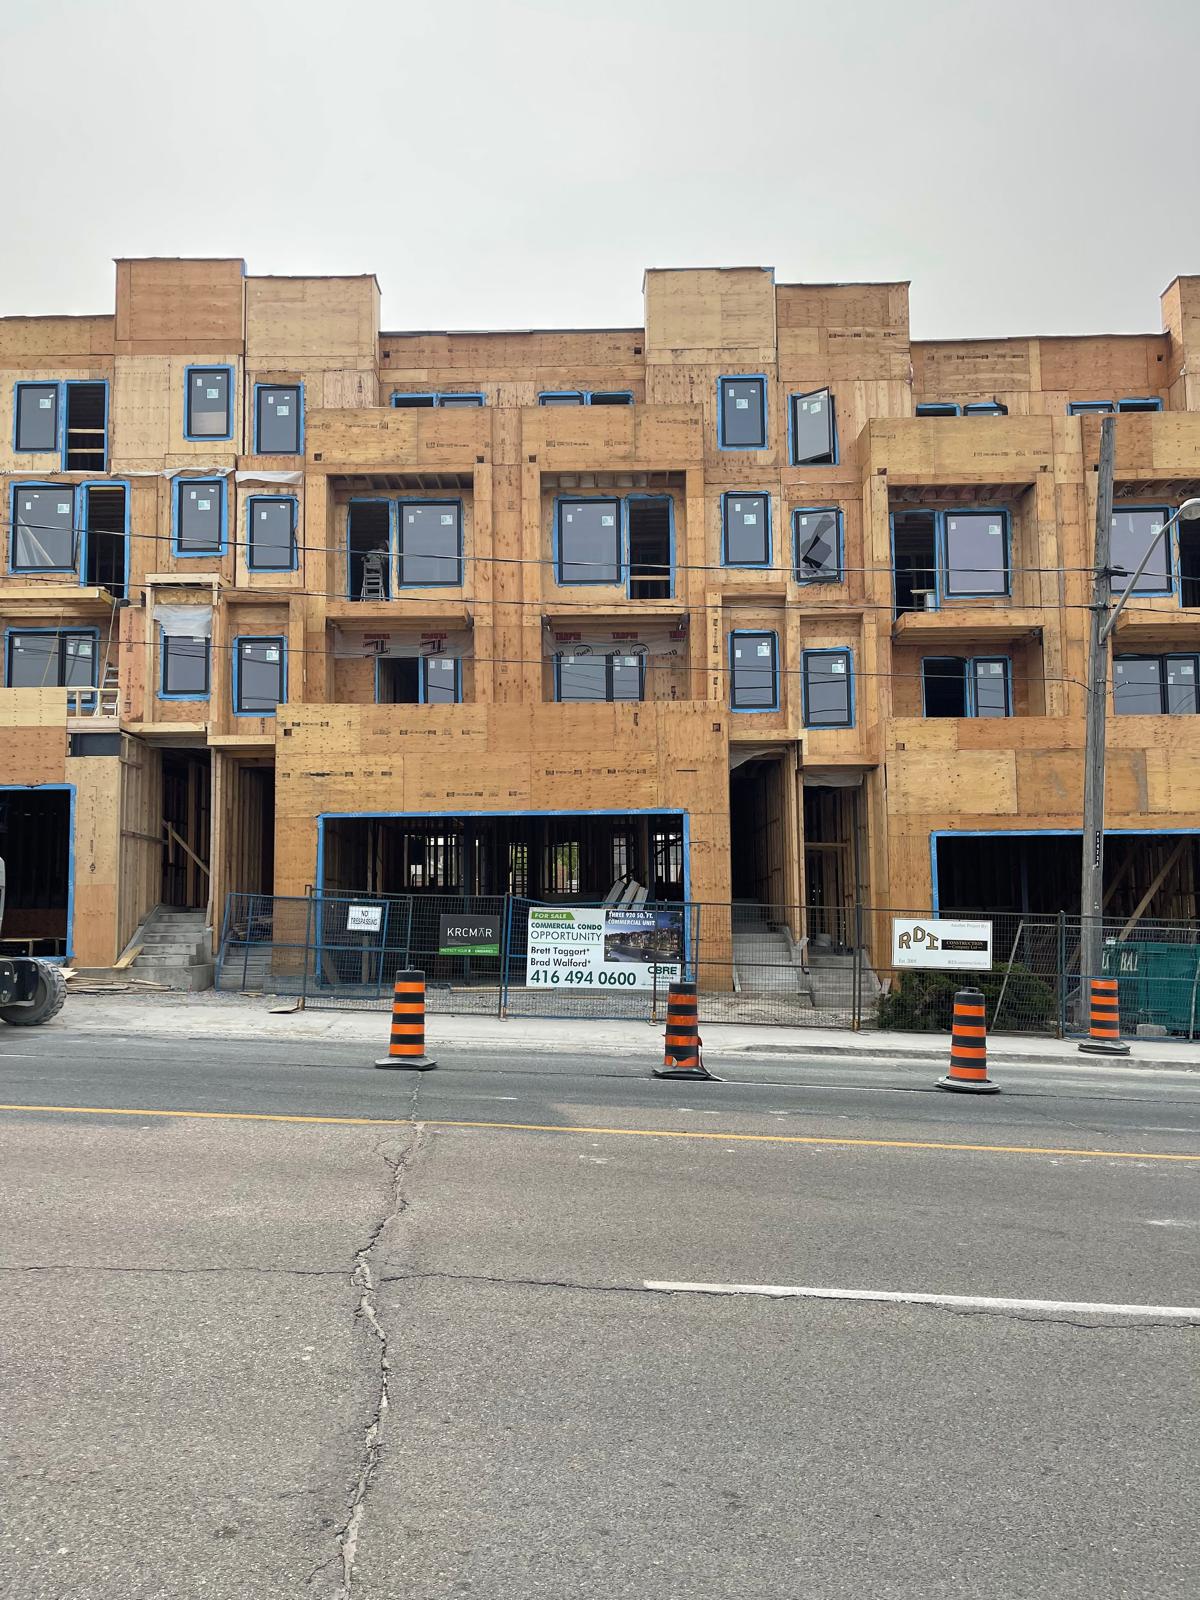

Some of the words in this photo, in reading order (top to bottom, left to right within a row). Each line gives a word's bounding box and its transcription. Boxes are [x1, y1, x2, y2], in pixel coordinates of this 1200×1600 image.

[351, 917, 377, 925] TRESPASSING
[531, 922, 575, 930] COMMERCIAL
[447, 927, 493, 938] KRCMAR
[531, 930, 602, 941] OPPORTUNITY
[898, 925, 939, 951] RDI
[531, 946, 551, 954] Brett
[530, 957, 550, 966] Brad
[647, 966, 677, 975] CBRE
[530, 969, 560, 984] 416
[564, 970, 594, 984] 494
[598, 971, 636, 986] 0600
